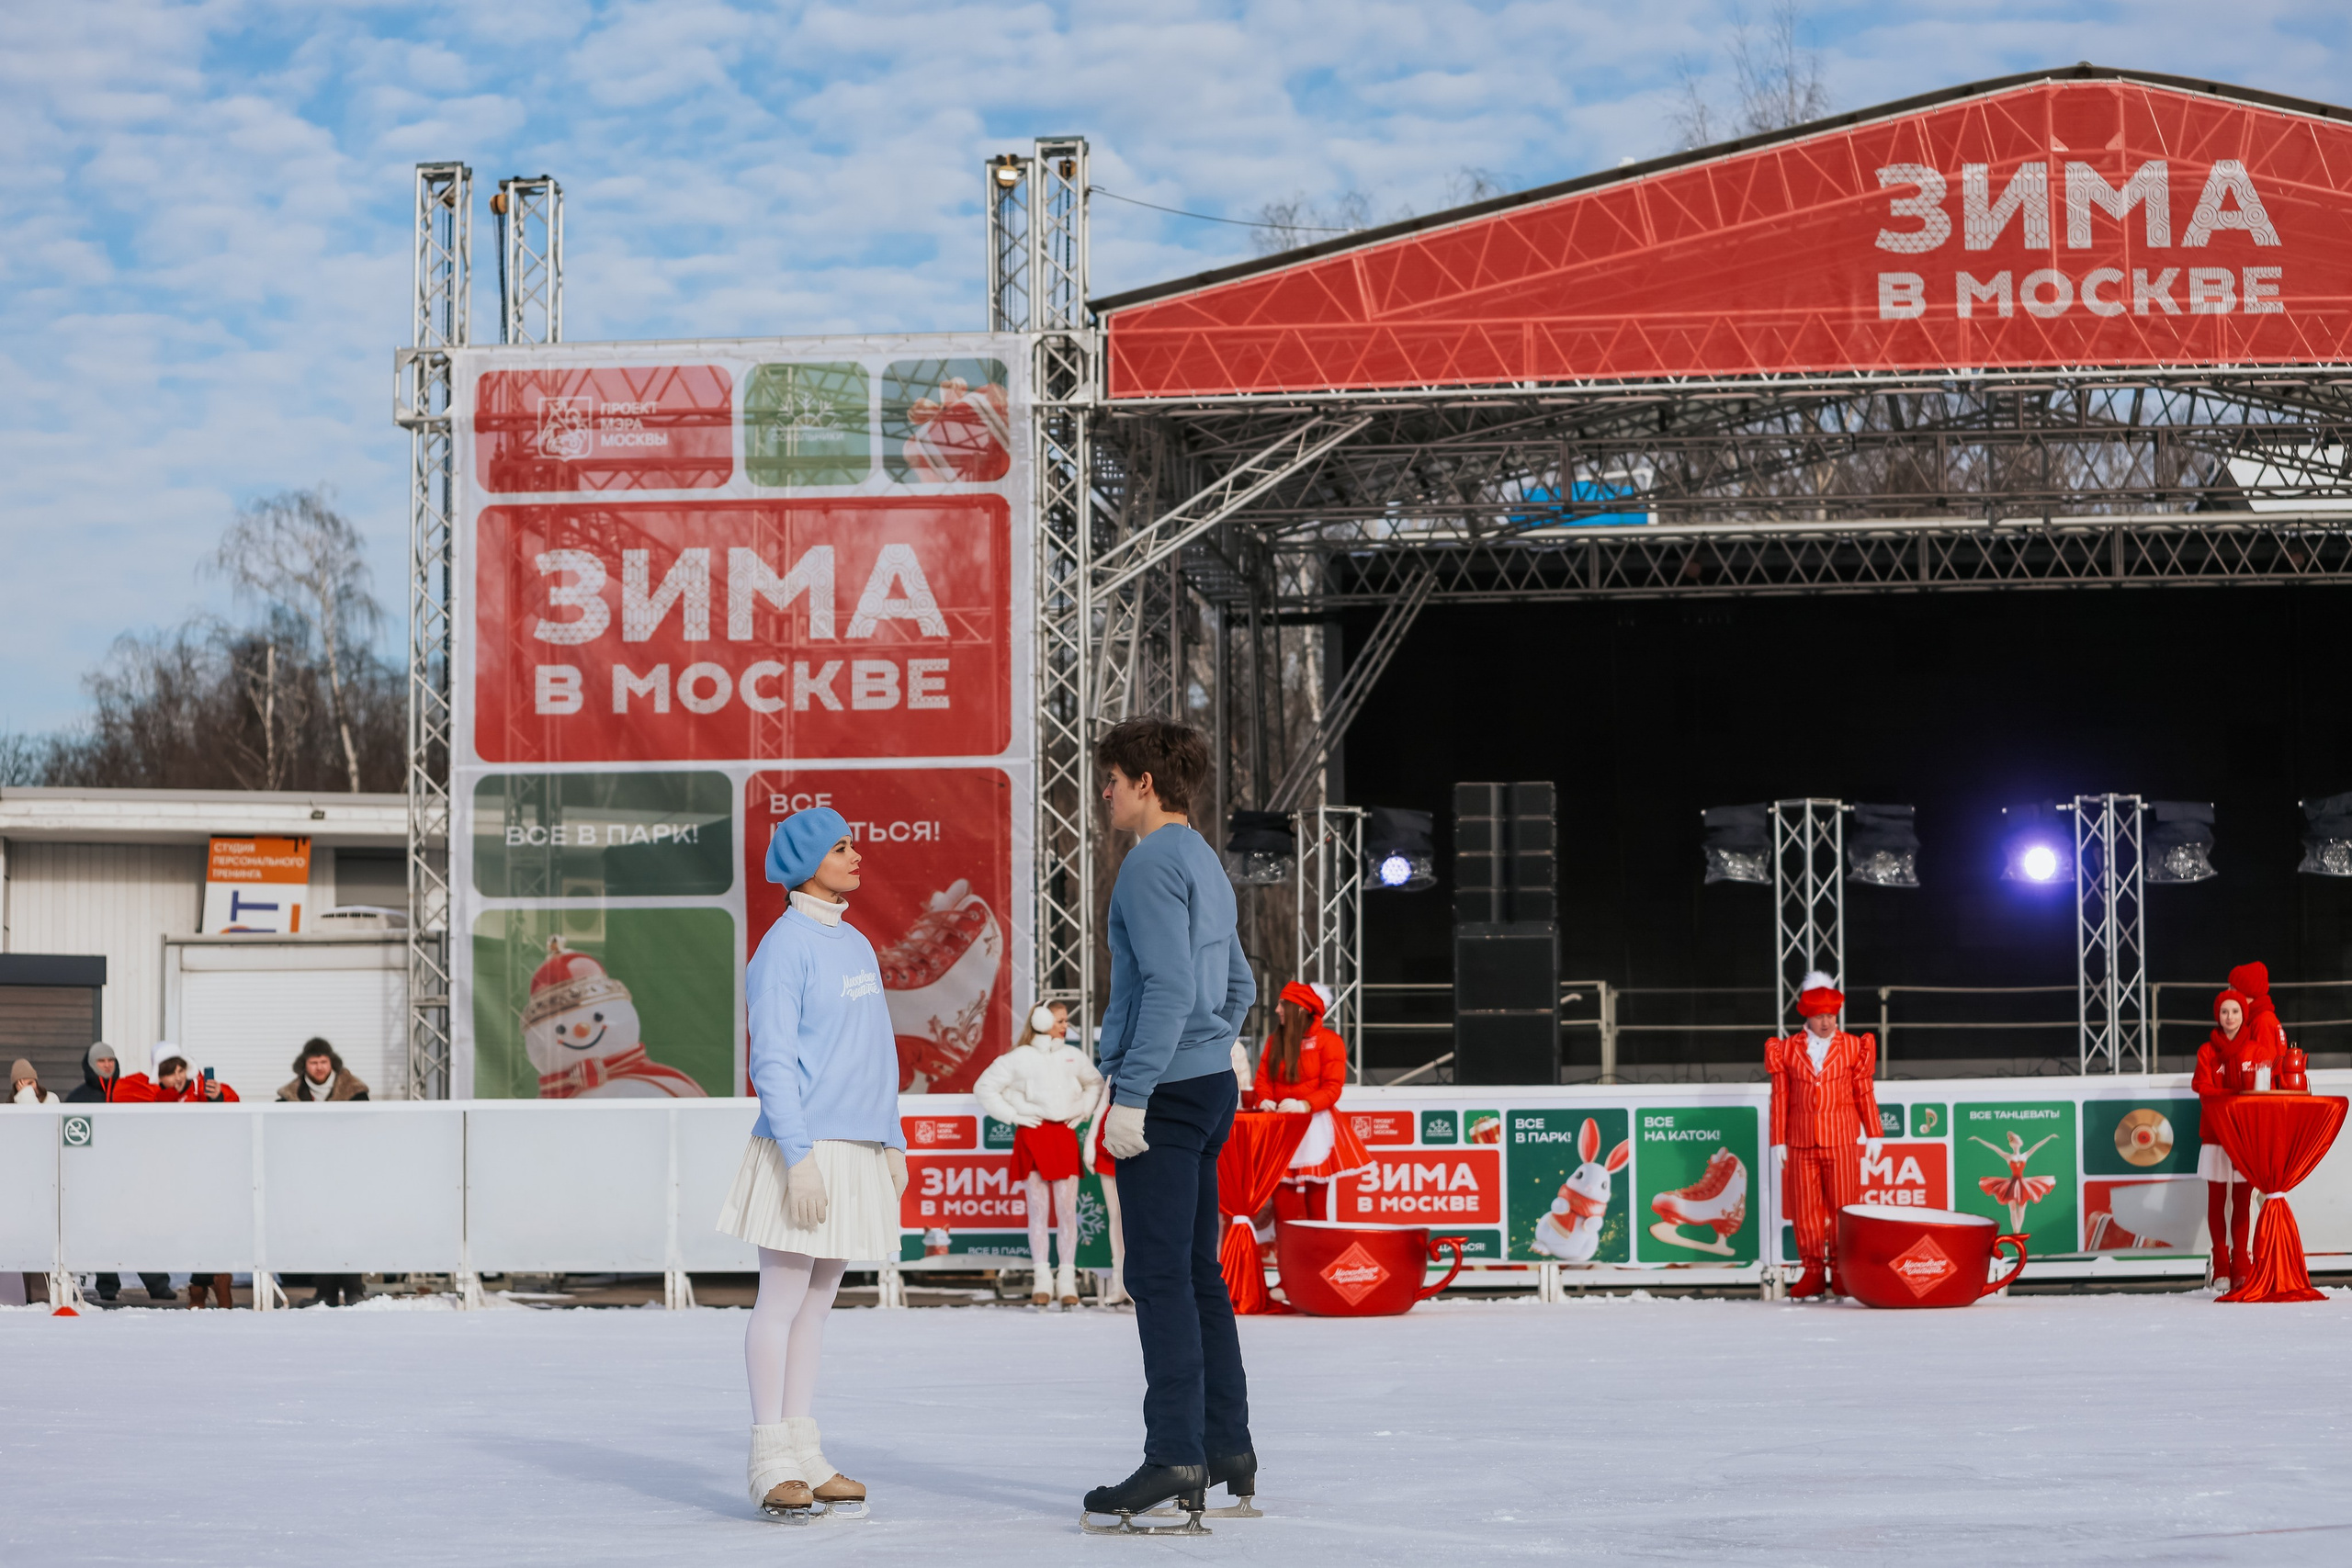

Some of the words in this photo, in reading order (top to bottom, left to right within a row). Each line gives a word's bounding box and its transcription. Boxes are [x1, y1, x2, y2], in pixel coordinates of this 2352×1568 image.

[1874, 159, 2282, 254] ЗИМА
[1878, 271, 1927, 320] В
[1955, 265, 2284, 319] МОСКВЕ
[600, 401, 660, 415] ПРОЕКТ
[600, 418, 643, 431] МЭРА
[600, 433, 668, 447] МОСКВЫ
[770, 431, 845, 443] СОКОЛЬНИКИ
[533, 543, 951, 645] ЗИМА
[535, 664, 584, 716] В
[612, 658, 951, 715] МОСКВЕ
[505, 825, 567, 846] ВСЕ
[577, 825, 597, 845] В
[607, 823, 699, 844] ПАРК!
[213, 842, 255, 854] СТУДИЯ
[212, 855, 306, 868] ПЕРСОНАЛЬНОГО
[211, 868, 263, 879] ТРЕНИНГА
[1645, 1116, 1675, 1128] ВСЕ
[1969, 1110, 1993, 1120] ВСЕ
[1995, 1109, 2061, 1121] ТАНЦЕВАТЬ!
[1515, 1118, 1545, 1130] ВСЕ
[1515, 1132, 1525, 1143] В
[1528, 1132, 1572, 1143] ПАРК!
[1645, 1131, 1667, 1142] НА
[1668, 1129, 1721, 1142] КАТОК!
[1356, 1162, 1479, 1192] ЗИМА
[1860, 1156, 1927, 1186] МА
[1357, 1197, 1374, 1213] В
[1380, 1195, 1479, 1212] МОСКВЕ
[1860, 1189, 1927, 1205] СКВЕ
[921, 1200, 936, 1216] В
[944, 1199, 1028, 1216] МОСКВ
[967, 1247, 989, 1256] ВСЕ
[991, 1247, 1000, 1256] В
[1001, 1247, 1031, 1256] ПАРК
